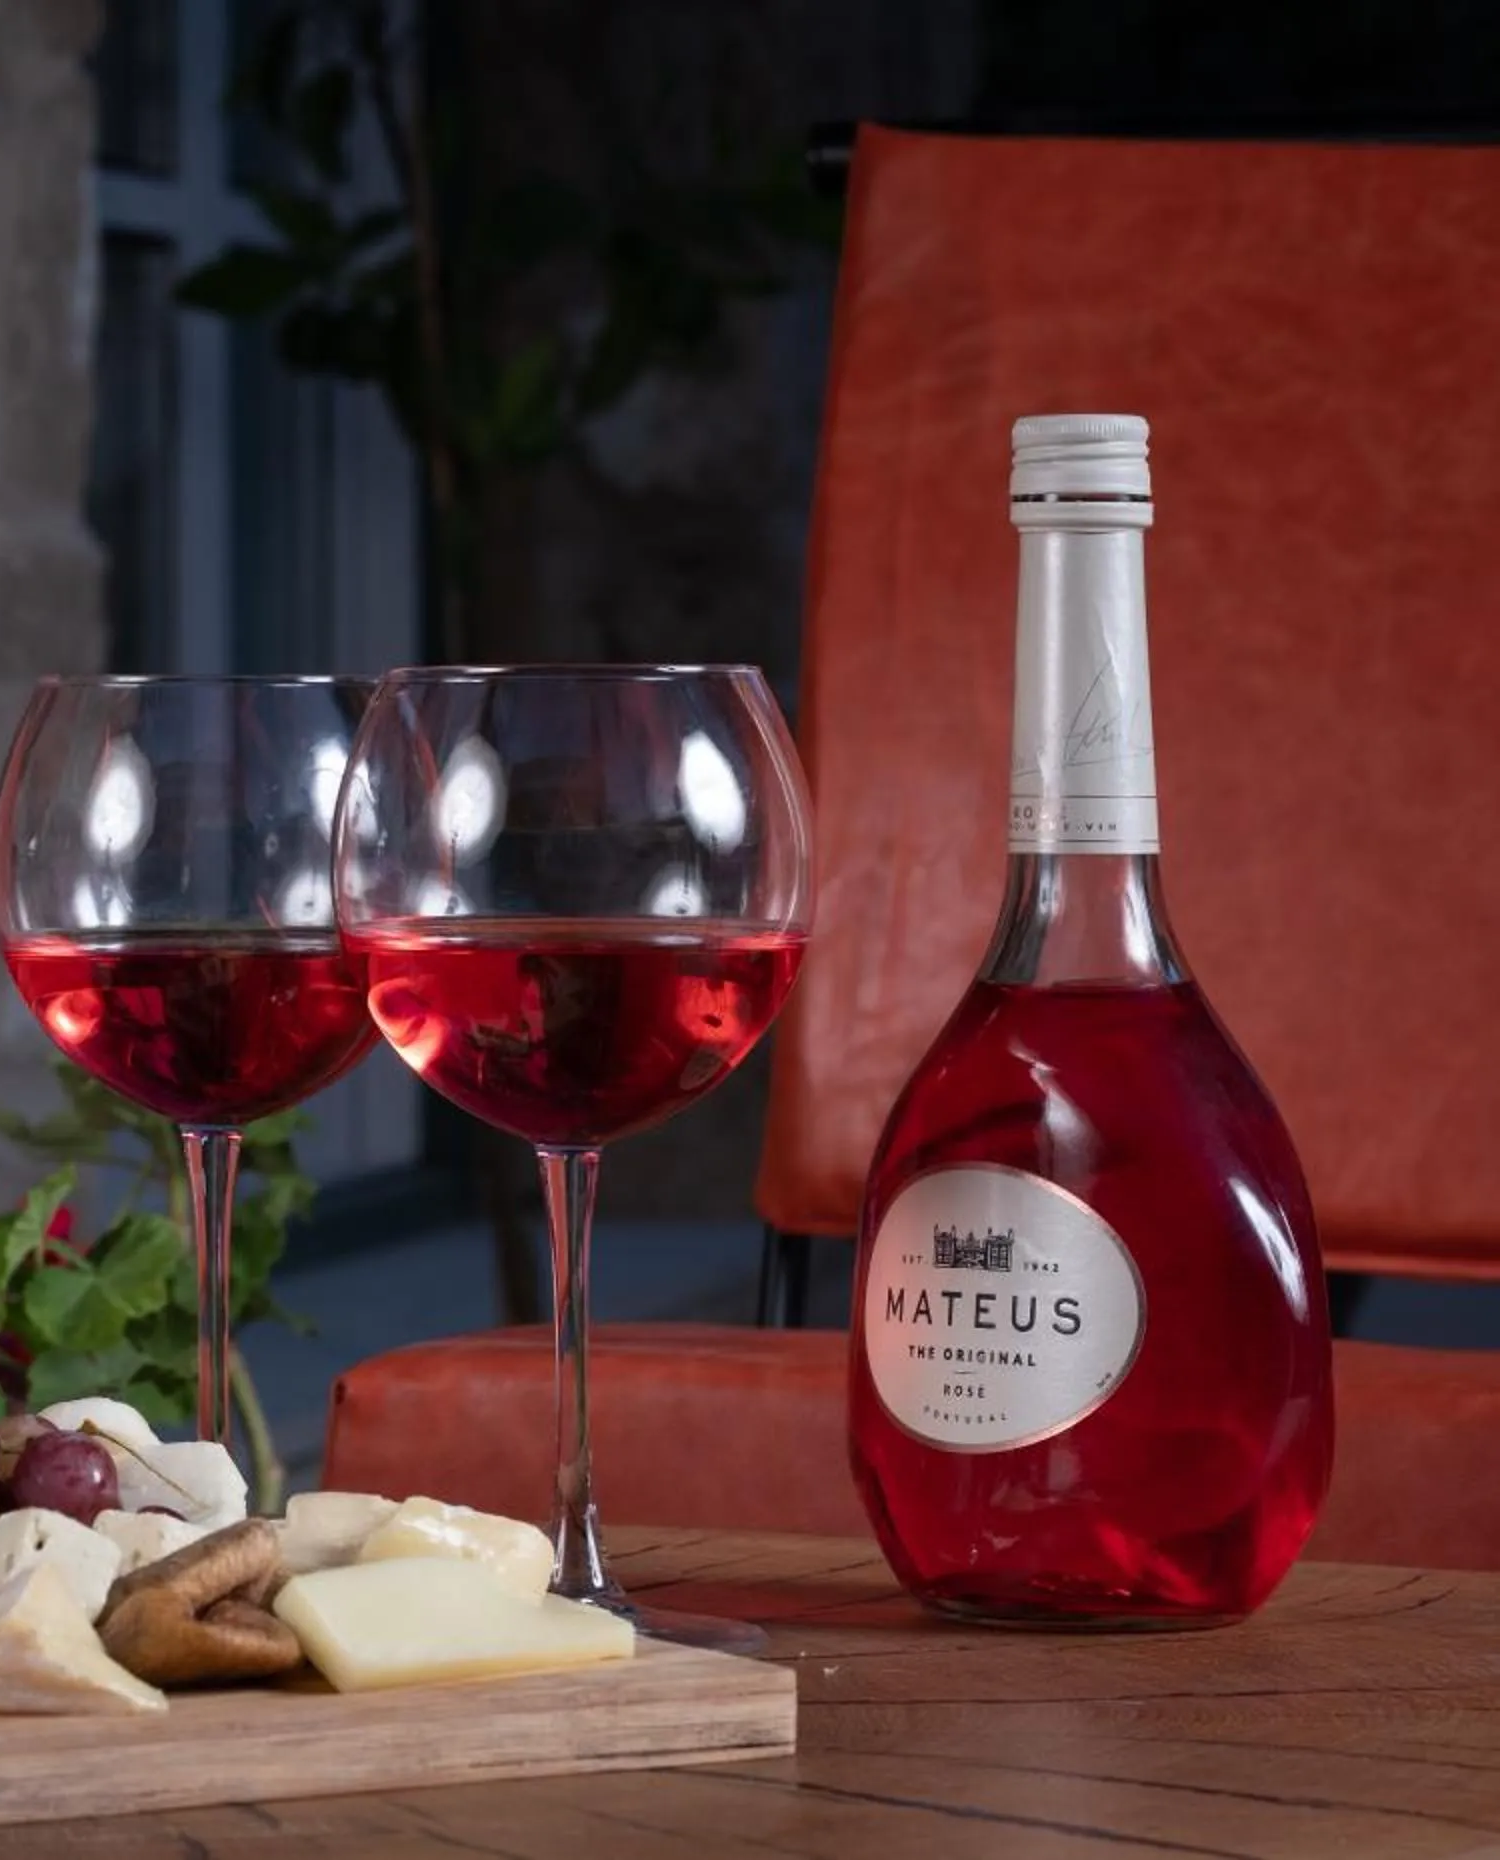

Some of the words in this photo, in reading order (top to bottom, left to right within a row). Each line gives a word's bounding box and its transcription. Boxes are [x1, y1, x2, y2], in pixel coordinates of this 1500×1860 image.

[885, 1287, 1081, 1335] MATEUS
[908, 1344, 936, 1361] THE
[942, 1346, 1037, 1367] ORIGINAL
